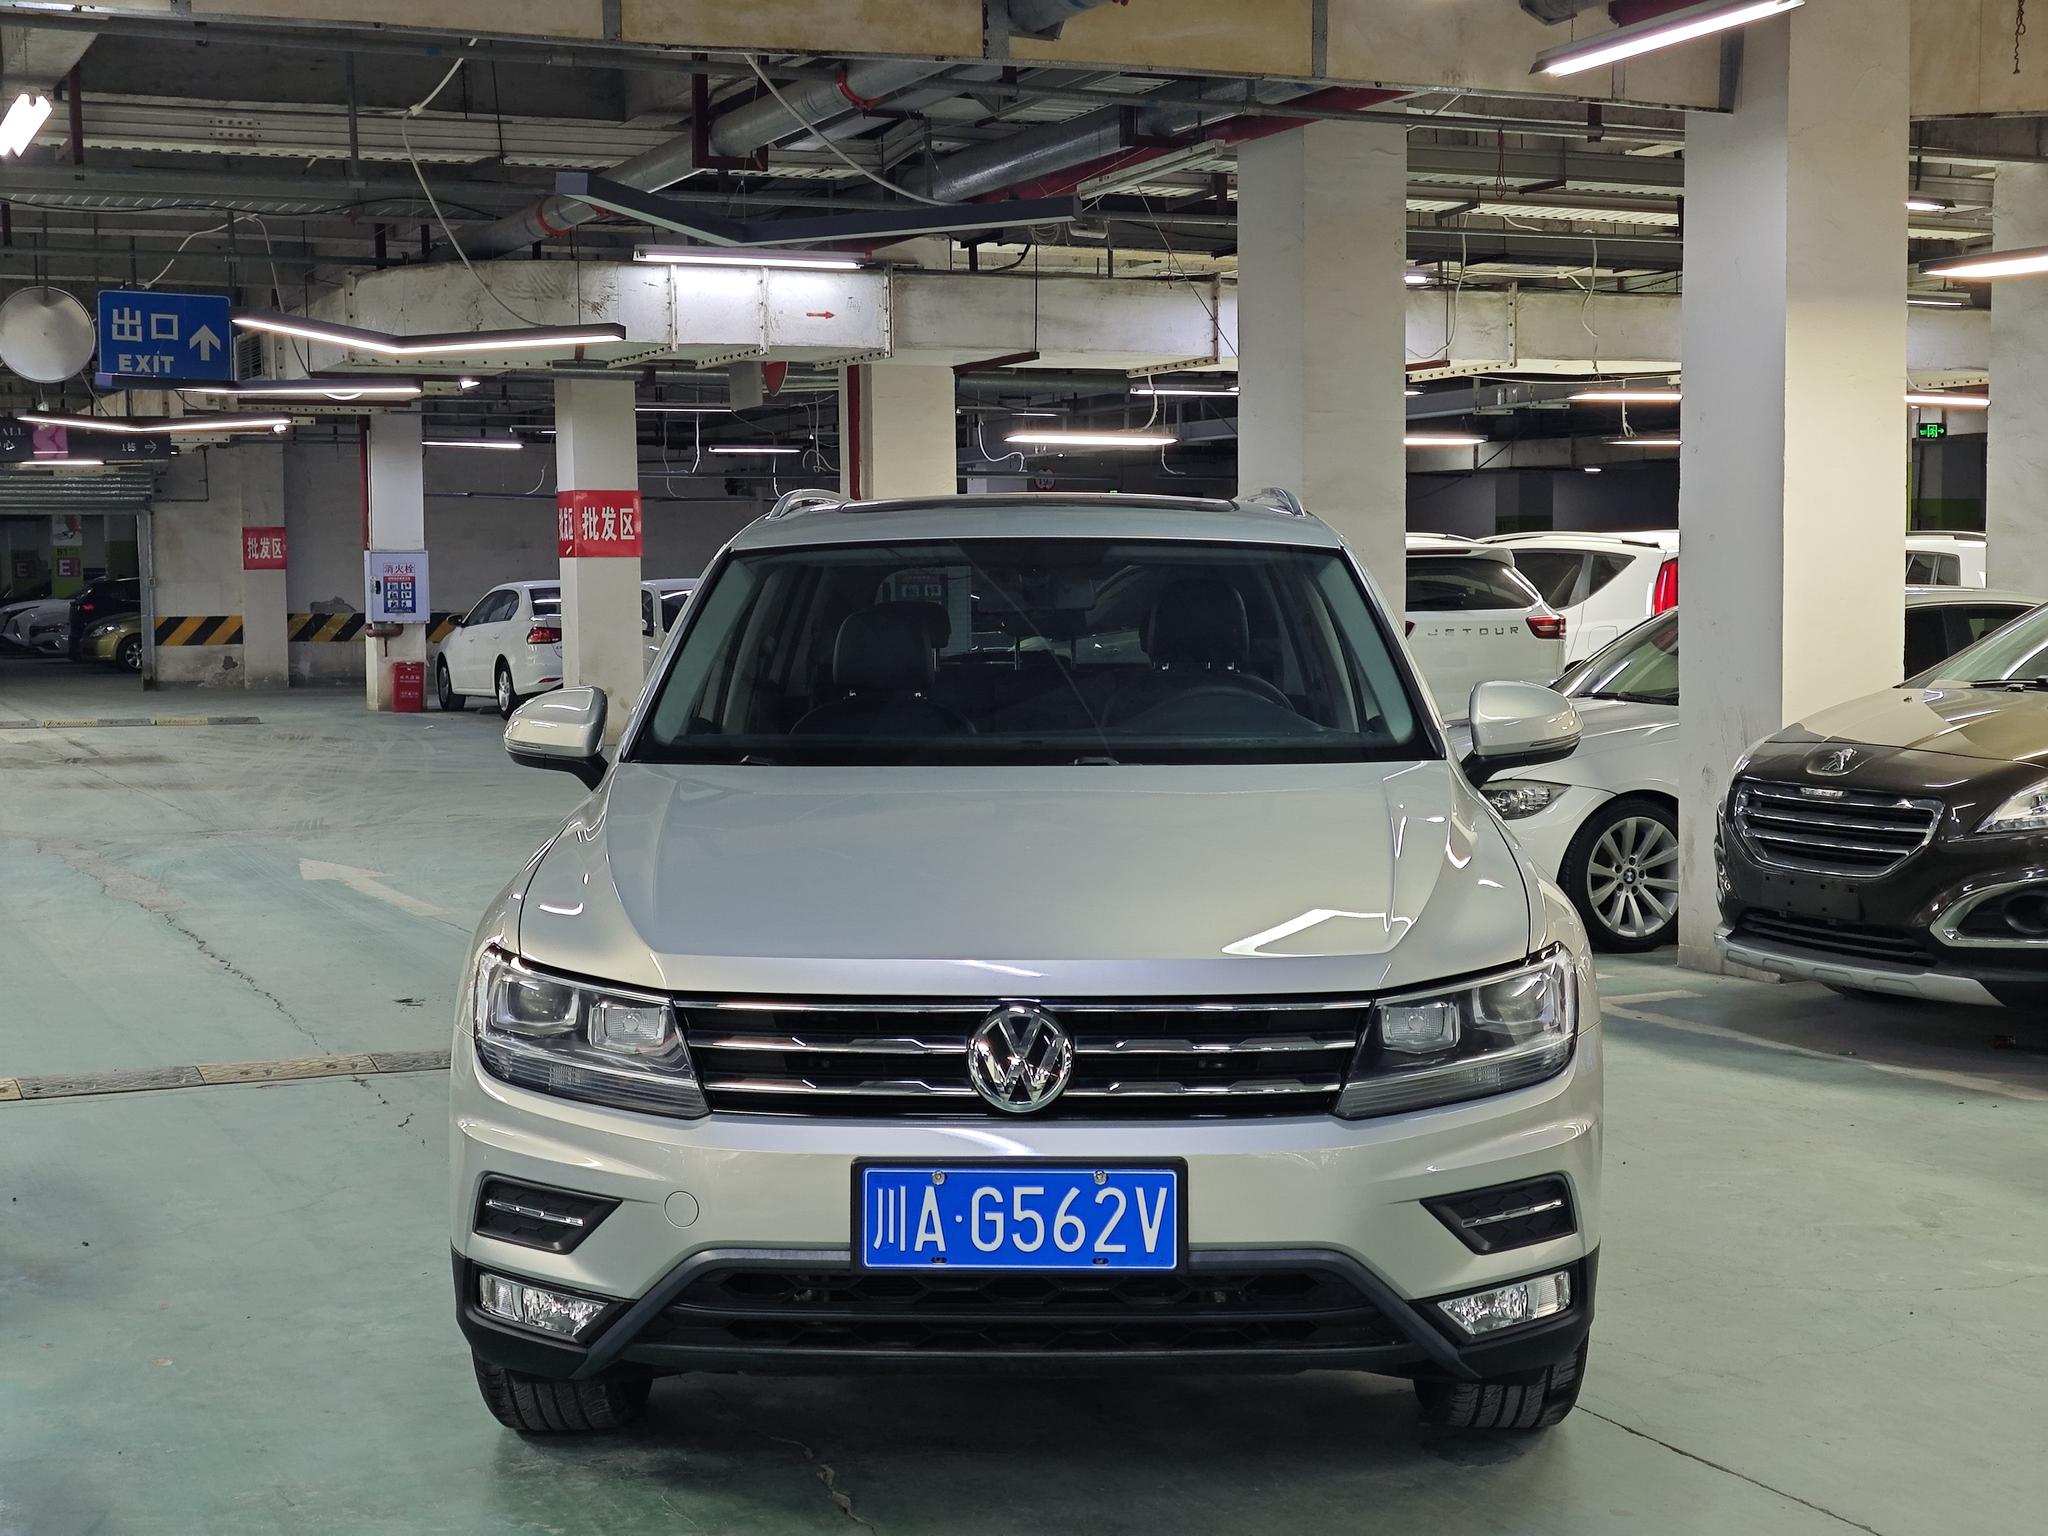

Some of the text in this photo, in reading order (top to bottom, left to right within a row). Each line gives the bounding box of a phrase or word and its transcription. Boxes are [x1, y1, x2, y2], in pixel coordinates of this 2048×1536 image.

[112, 307, 178, 342] 出口
[118, 353, 175, 374] EXIT
[581, 506, 635, 541] 批发区
[247, 537, 283, 559] 批发区
[1427, 626, 1520, 637] JETOUR
